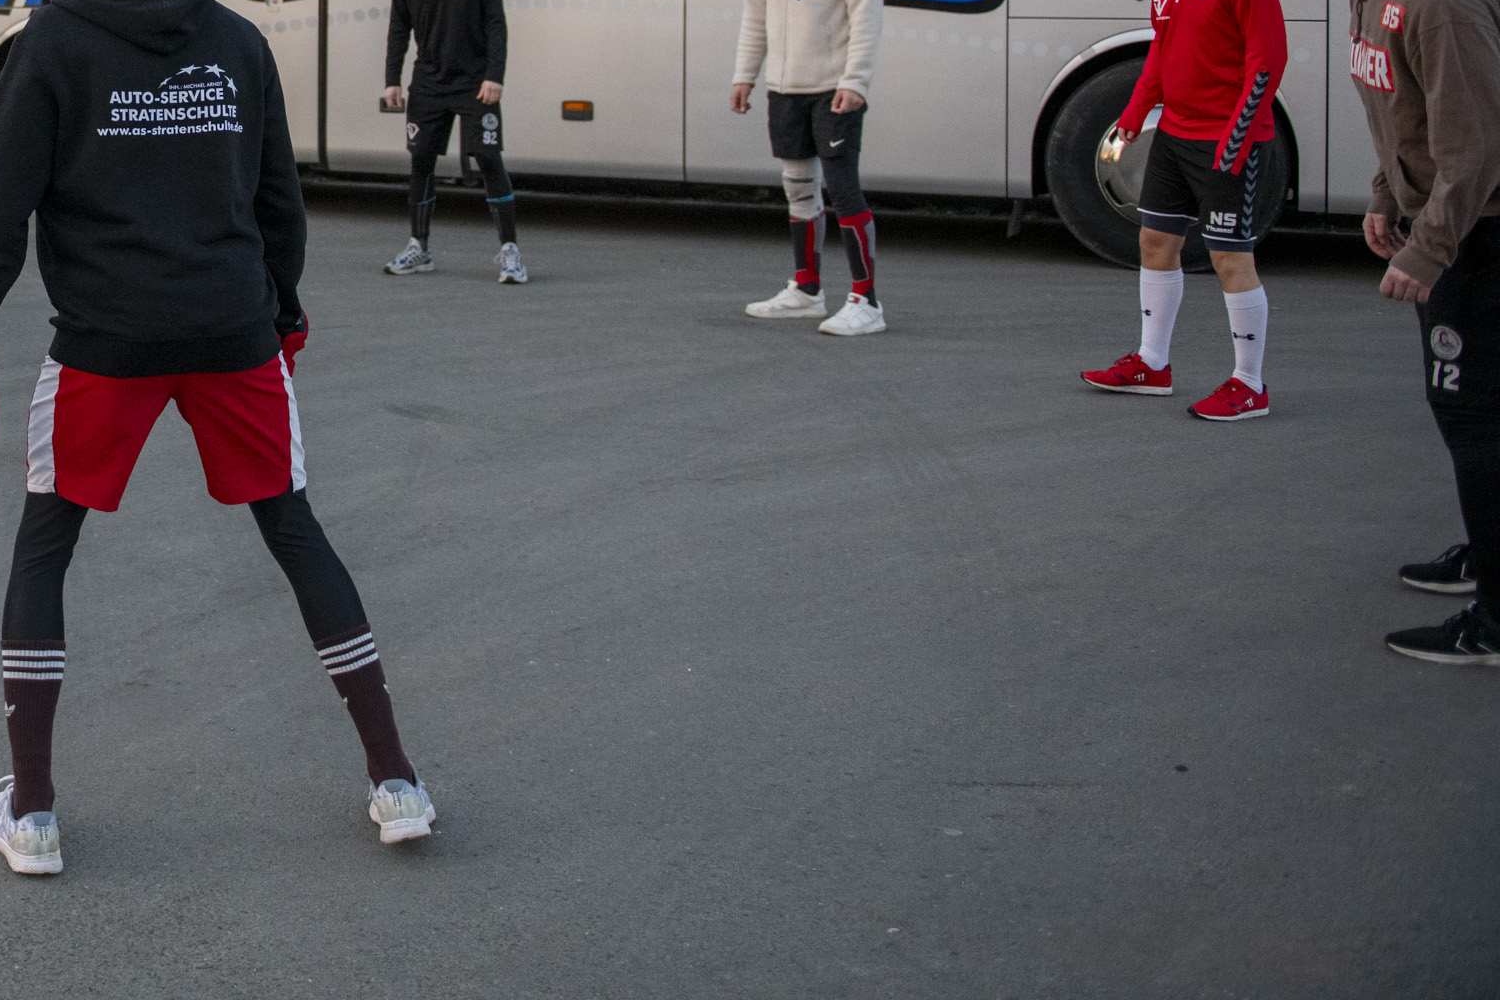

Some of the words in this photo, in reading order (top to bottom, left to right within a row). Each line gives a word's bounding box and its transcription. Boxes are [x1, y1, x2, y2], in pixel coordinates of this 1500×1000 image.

[109, 88, 225, 105] AUTO-SERVICE
[111, 105, 237, 122] STRATENSCHULTE
[97, 120, 243, 136] www.as-stratenschulte.de
[483, 131, 498, 145] 92
[1210, 211, 1237, 227] NS
[1432, 360, 1460, 391] 12
